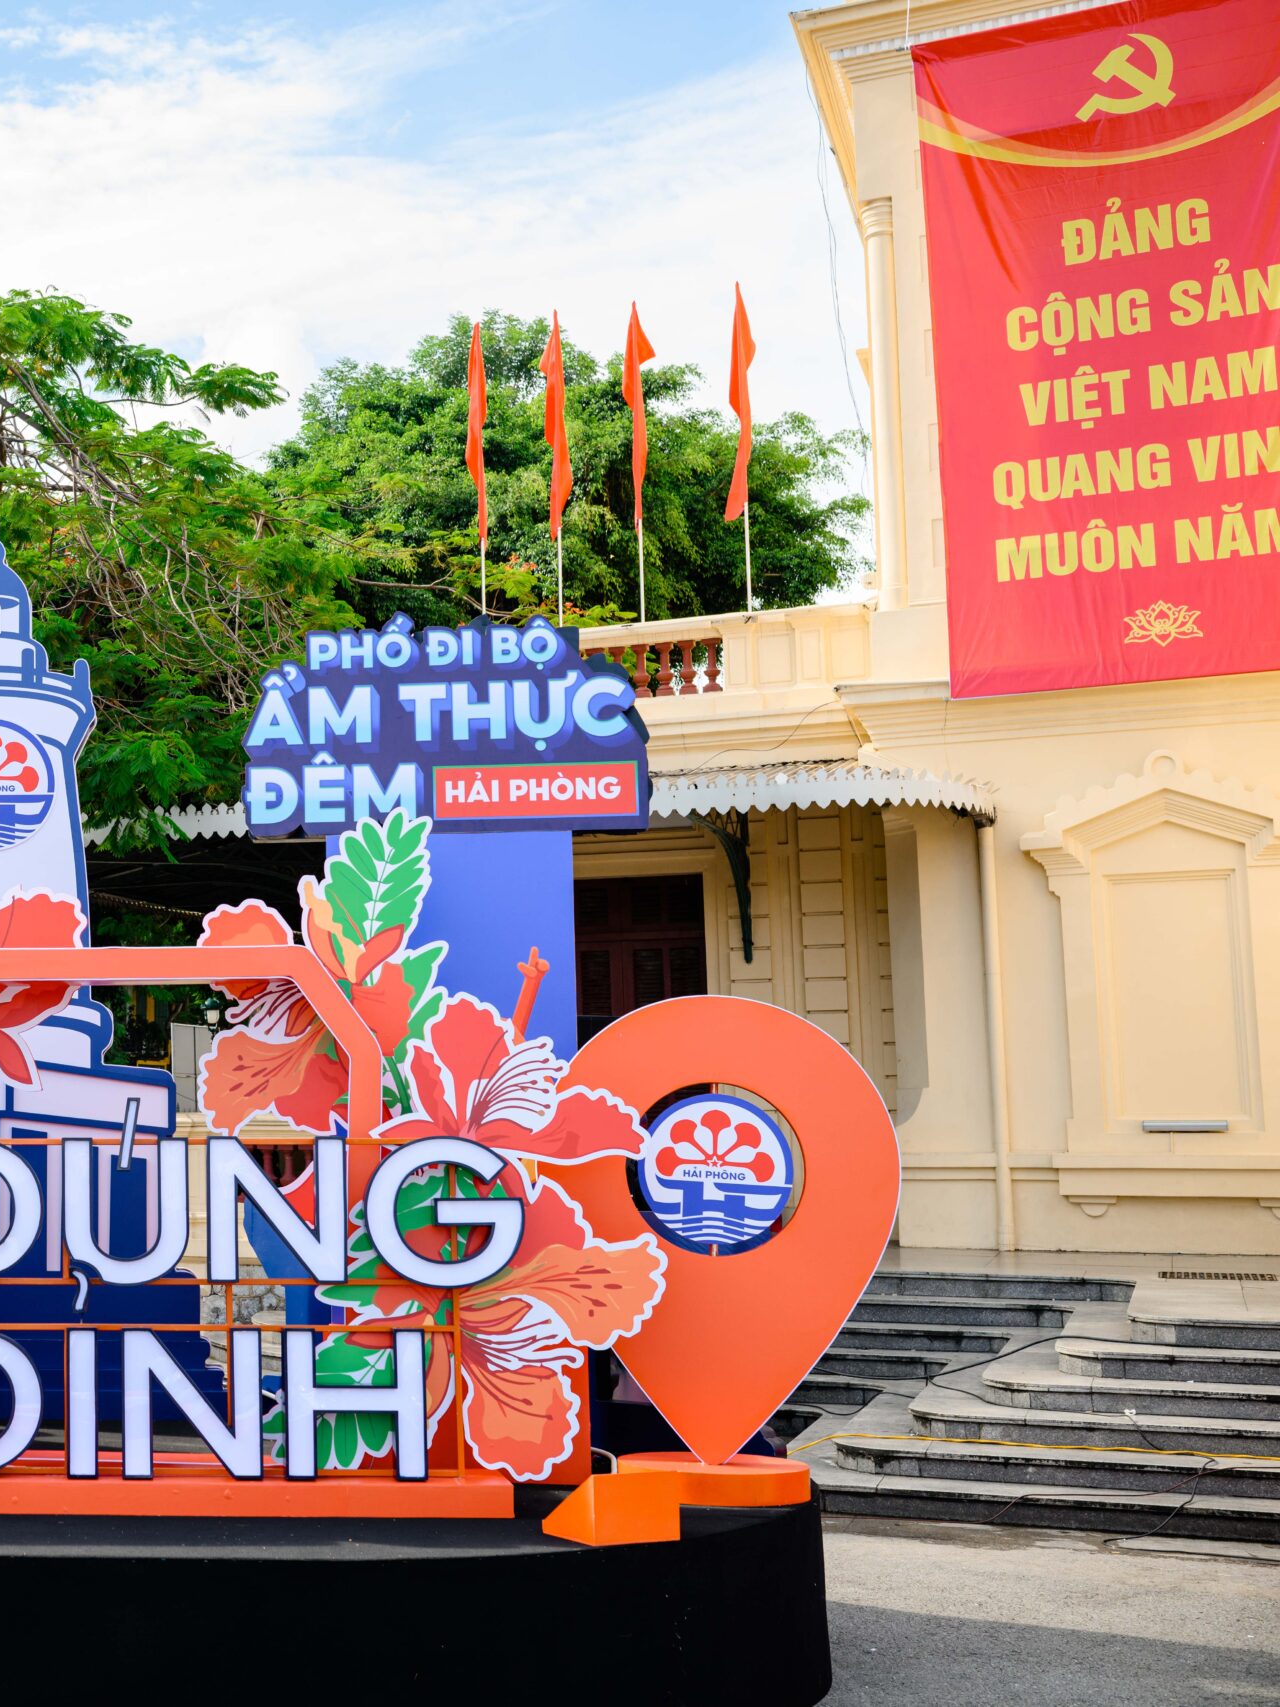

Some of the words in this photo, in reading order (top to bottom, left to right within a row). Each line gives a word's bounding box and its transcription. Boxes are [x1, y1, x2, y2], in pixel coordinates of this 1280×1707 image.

[1061, 197, 1211, 266] ĐẢNG
[1006, 289, 1151, 356] CỘNG
[1170, 258, 1280, 327] SẢN
[1019, 365, 1130, 430] VIỆT
[1149, 345, 1278, 410] NAM
[993, 444, 1171, 510] QUANG
[995, 519, 1156, 583] MUÔN
[310, 614, 413, 671] PHỐ
[425, 629, 474, 667] ĐI
[491, 619, 558, 671] BỘ
[246, 666, 373, 747] ẨM
[398, 669, 629, 752] THỰC
[246, 751, 417, 825] ĐÊM
[445, 772, 500, 804] HẢI
[514, 771, 621, 802] PHÒNG
